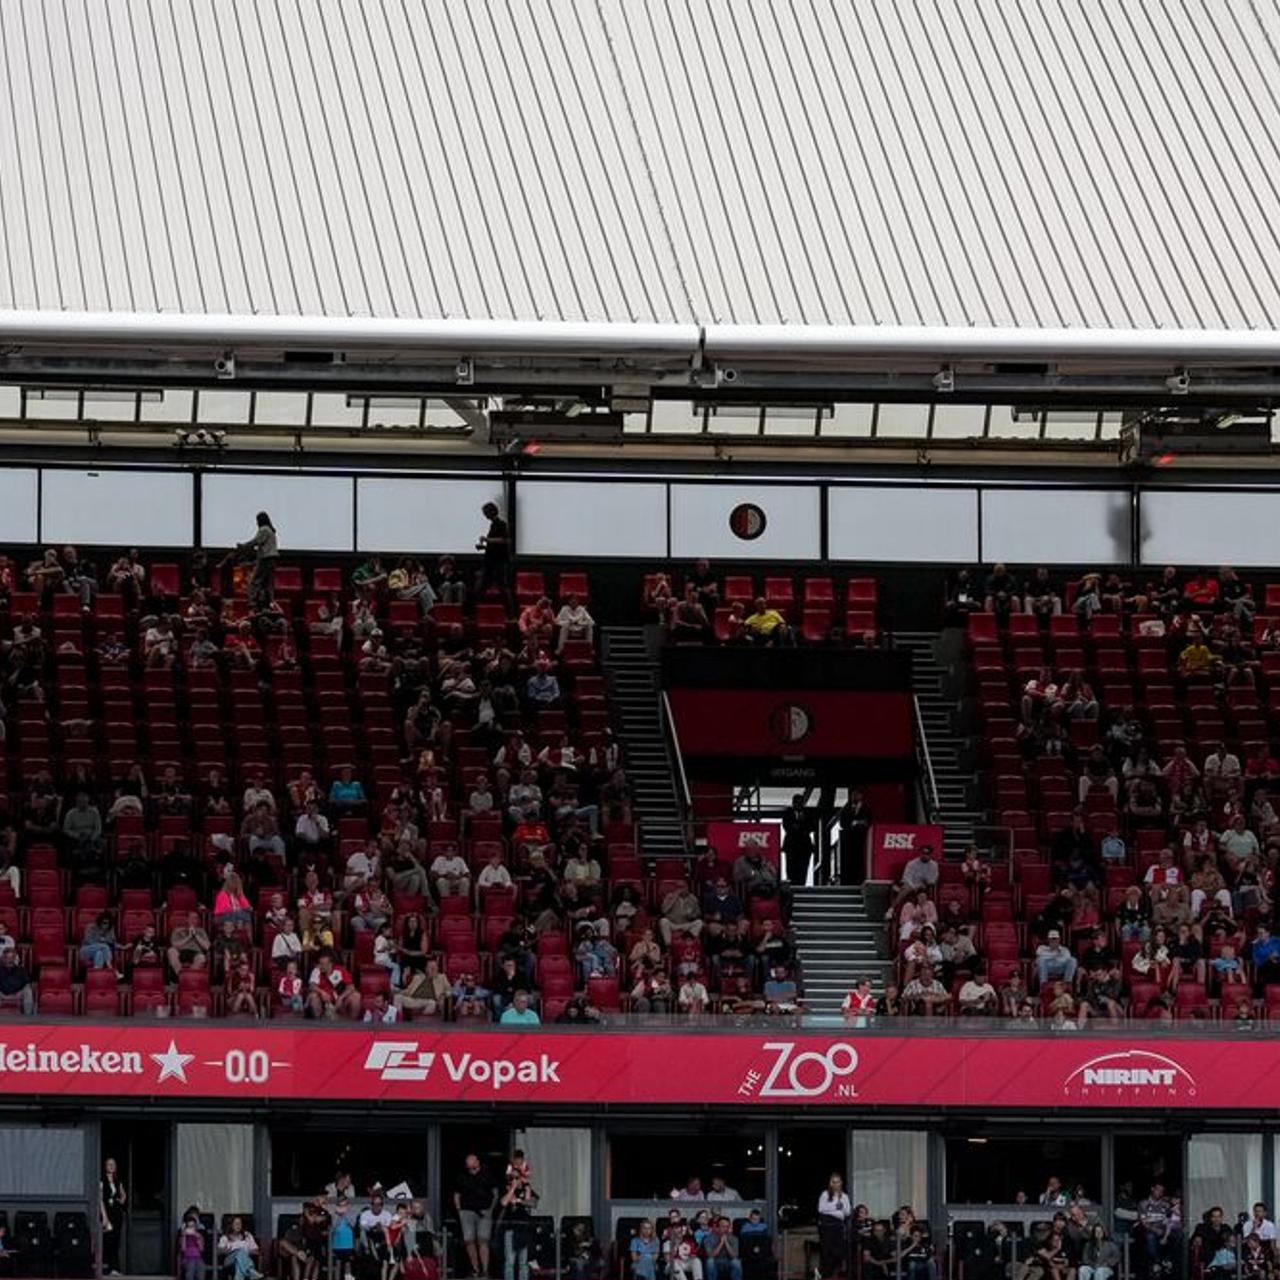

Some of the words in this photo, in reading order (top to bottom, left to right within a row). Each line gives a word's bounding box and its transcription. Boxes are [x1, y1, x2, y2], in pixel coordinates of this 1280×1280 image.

[442, 1052, 561, 1089] Vopak
[737, 1067, 762, 1097] THE
[1082, 1068, 1177, 1086] NIRINT
